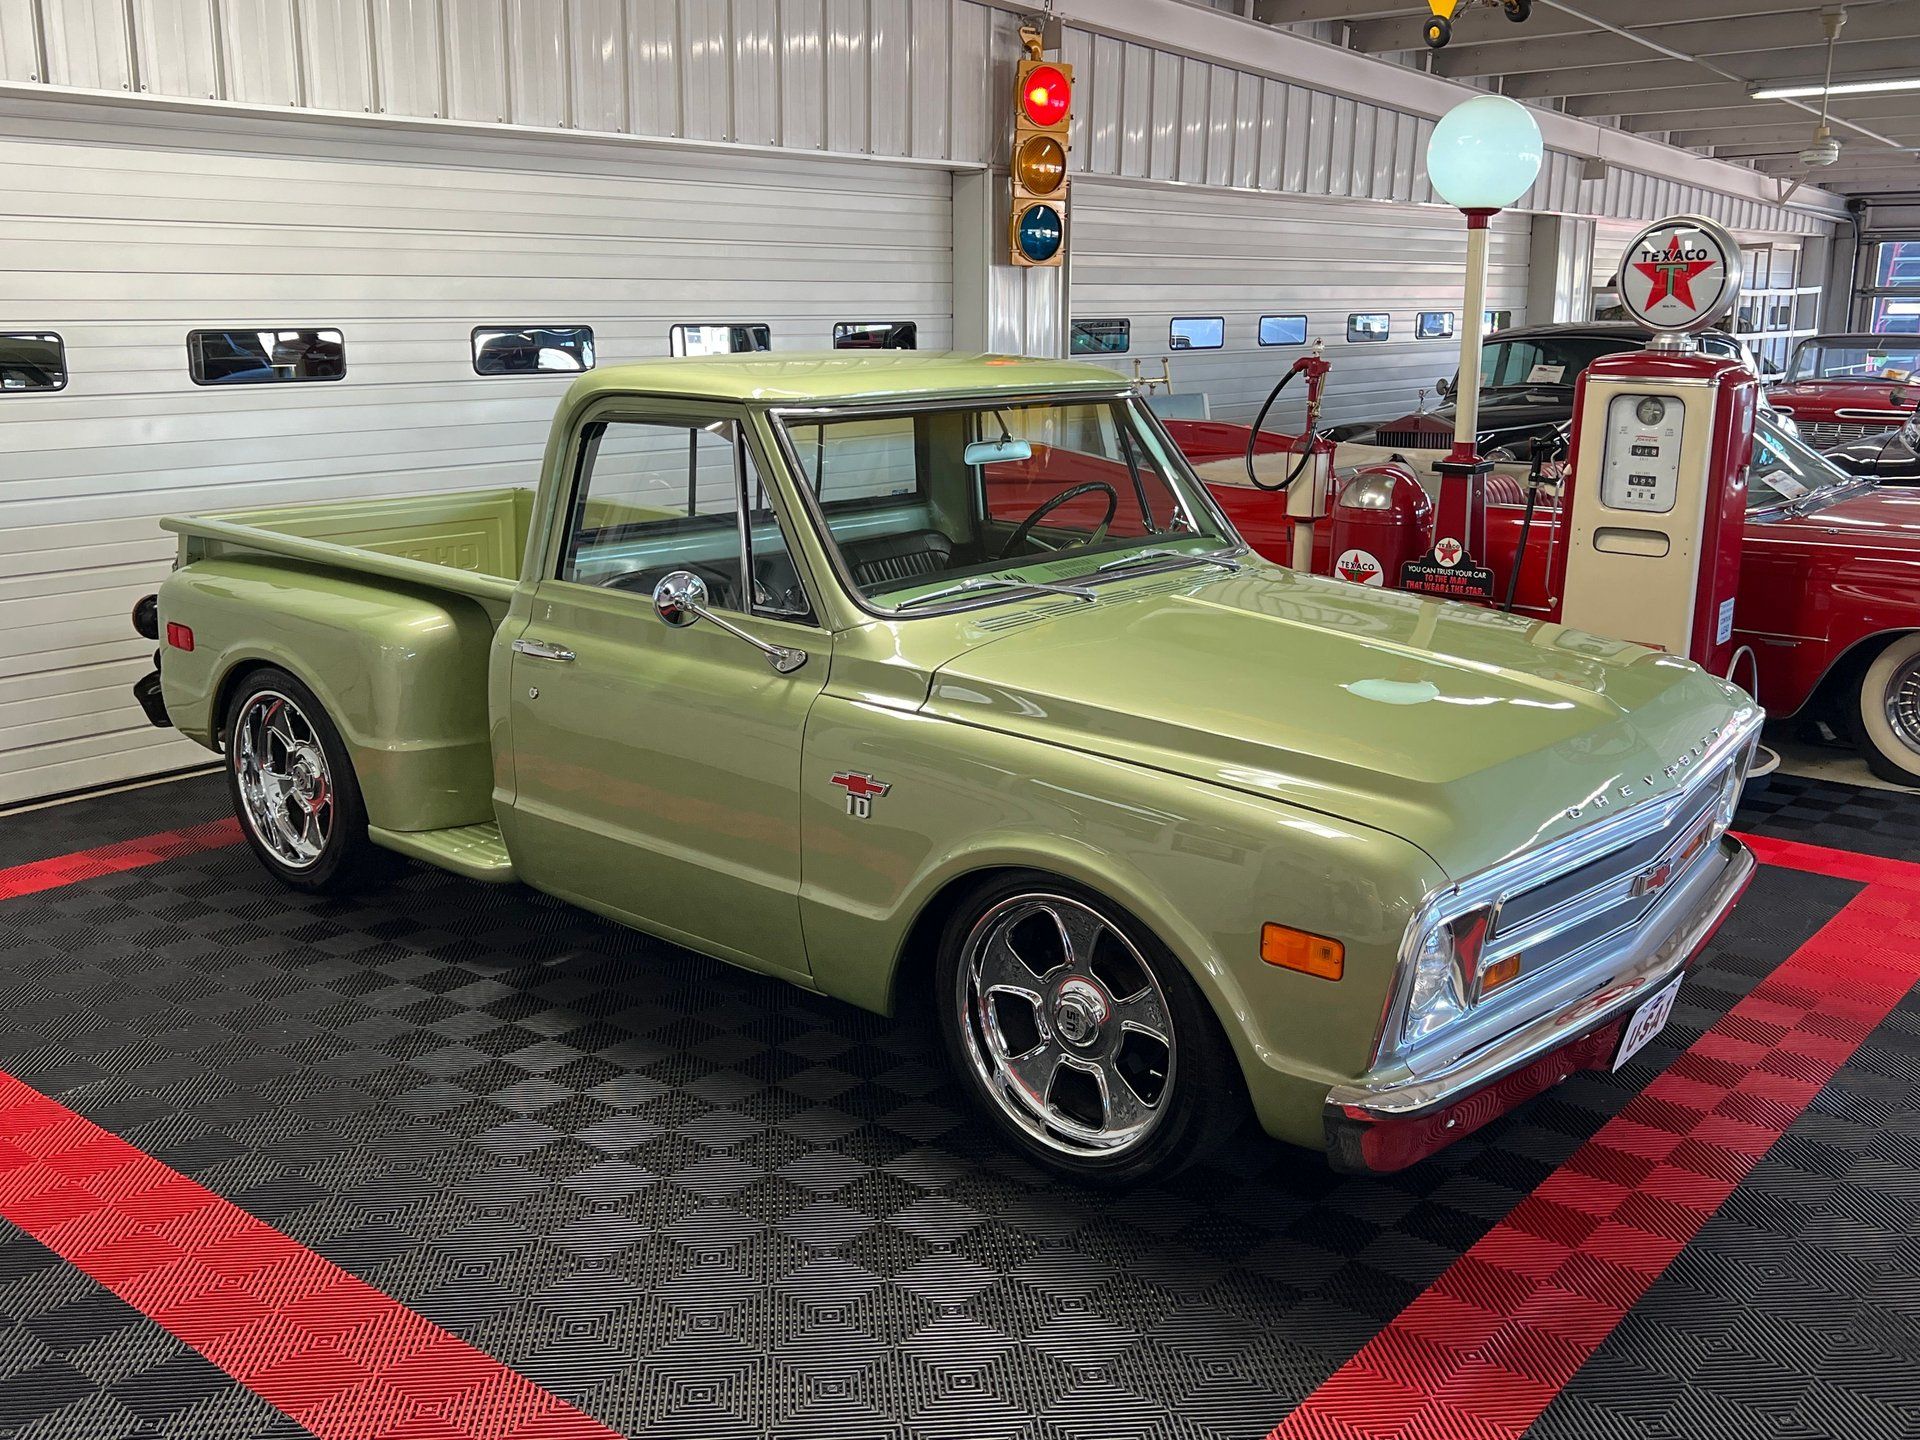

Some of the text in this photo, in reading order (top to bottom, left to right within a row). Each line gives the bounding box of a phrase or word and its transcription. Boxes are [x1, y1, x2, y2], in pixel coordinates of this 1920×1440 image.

[1642, 249, 1707, 262] TEXACO
[1655, 263, 1688, 296] T
[1341, 561, 1375, 570] TEXACO
[1408, 565, 1487, 579] YOU CAN TRUST YOUR CAR
[1406, 580, 1422, 589] THAT
[1424, 582, 1449, 592] WEARS
[1450, 584, 1463, 593] THE
[1435, 575, 1447, 583] THE
[1449, 576, 1468, 585] MAN
[1566, 727, 1720, 819] CHEVROLET
[846, 794, 871, 819] 10
[1066, 1010, 1077, 1033] US
